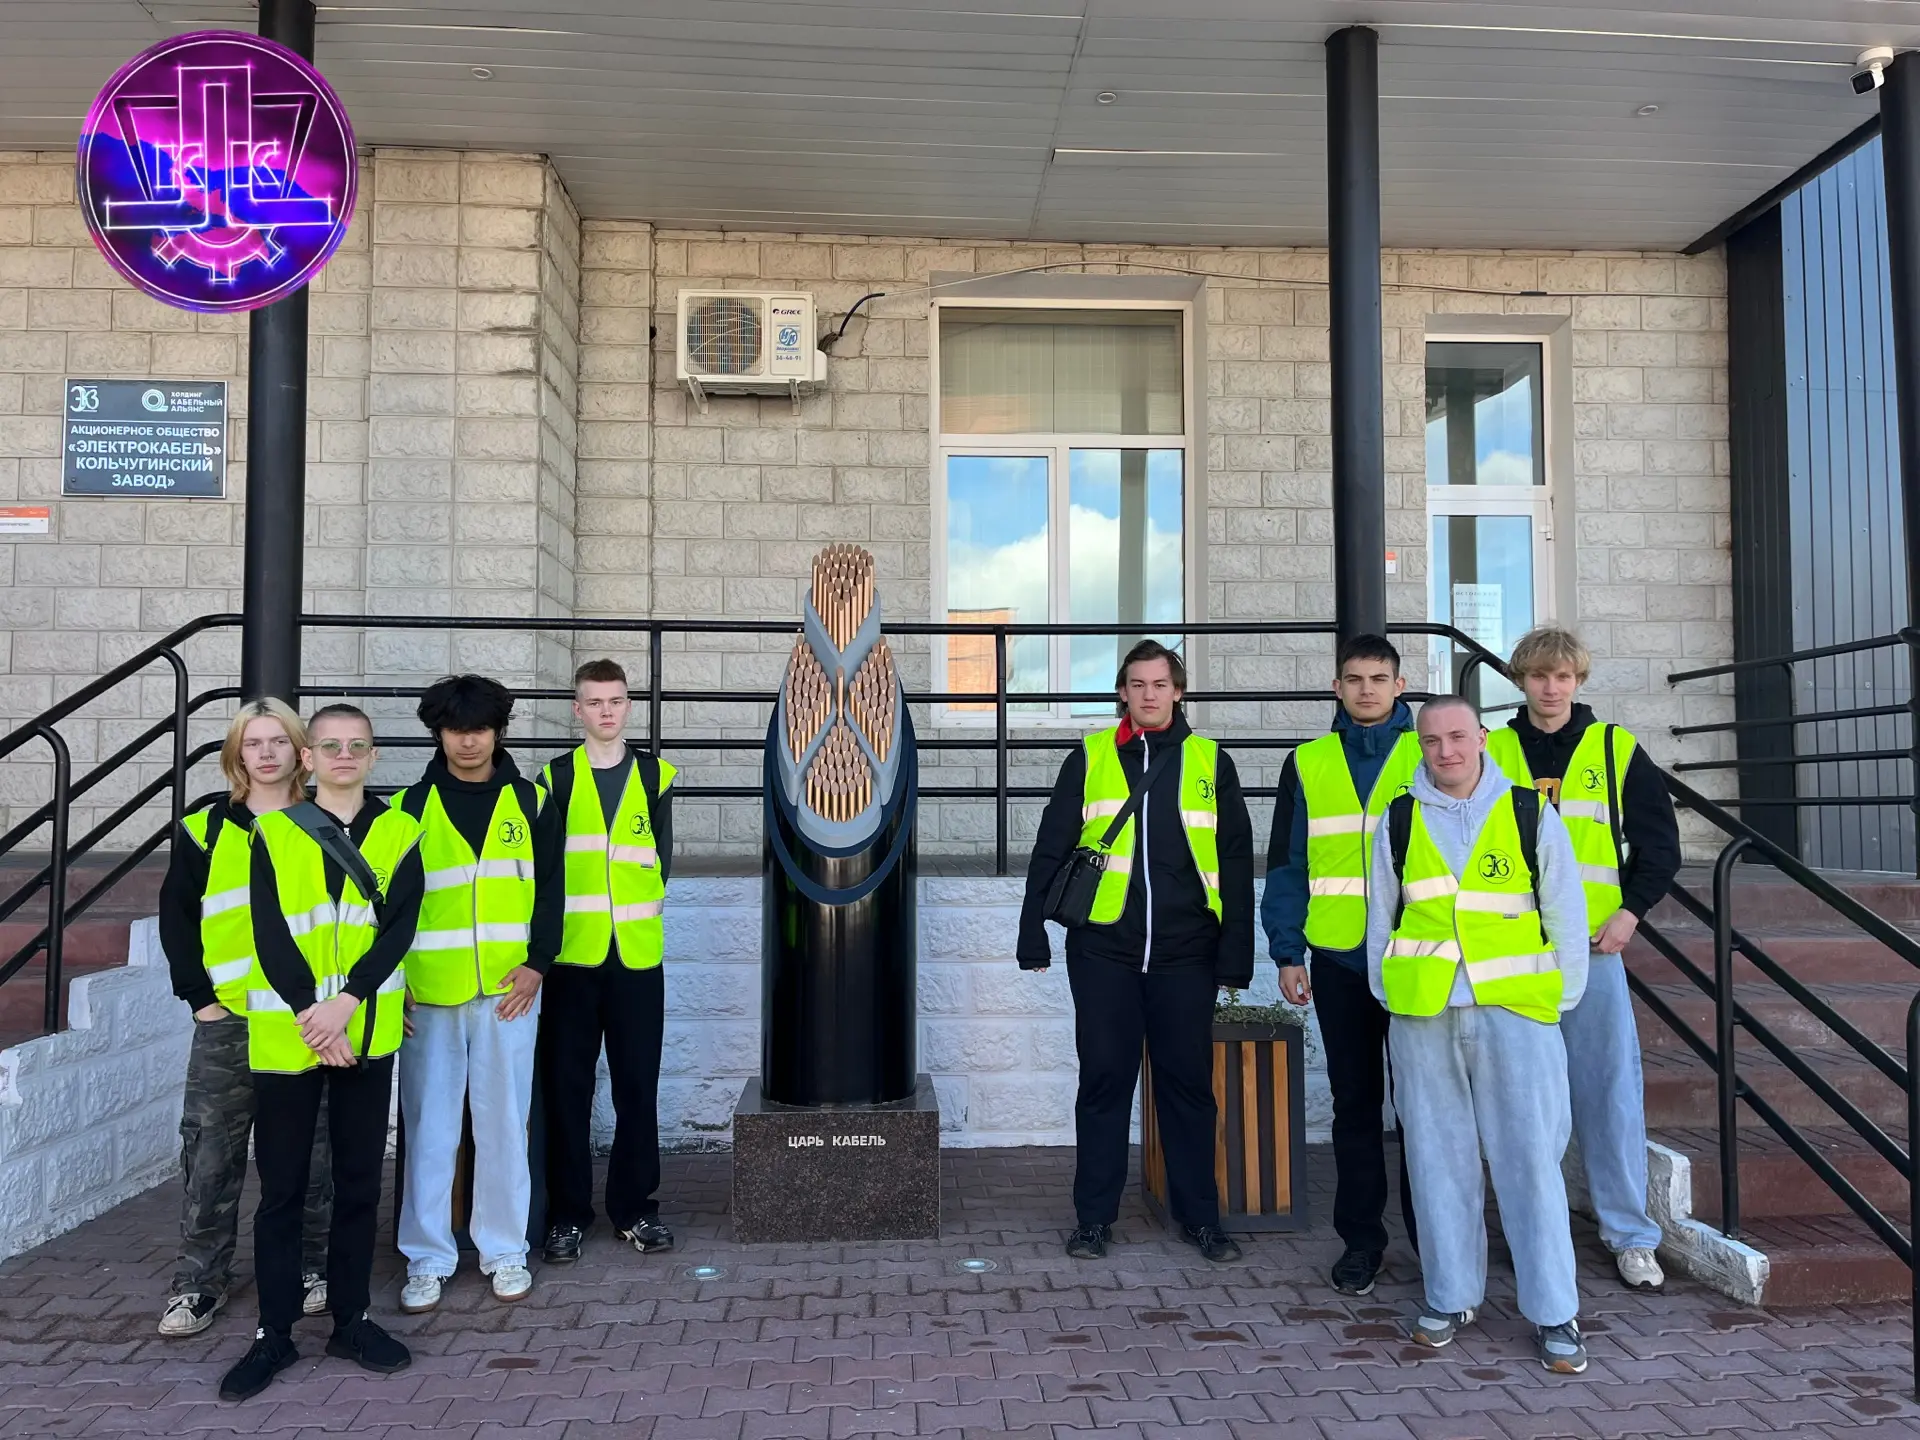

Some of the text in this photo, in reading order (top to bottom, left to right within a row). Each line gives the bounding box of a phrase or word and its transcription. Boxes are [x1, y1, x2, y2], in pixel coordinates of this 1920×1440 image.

[170, 398, 223, 407] КАБЕЛЬНЫЙ
[170, 405, 205, 413] АЛЬЯНС
[70, 425, 220, 438] АКЦИОНЕРНОЕ ОБЩЕСТВО
[68, 440, 222, 456] «ЭЛЕКТРОКАБЕЛЬ»
[76, 457, 213, 472] КОЛЬЧУГИНСКИЙ
[111, 474, 176, 489] ЗАВОД»
[788, 1135, 886, 1148] ЦАРЬ КАБЕЛЬ
